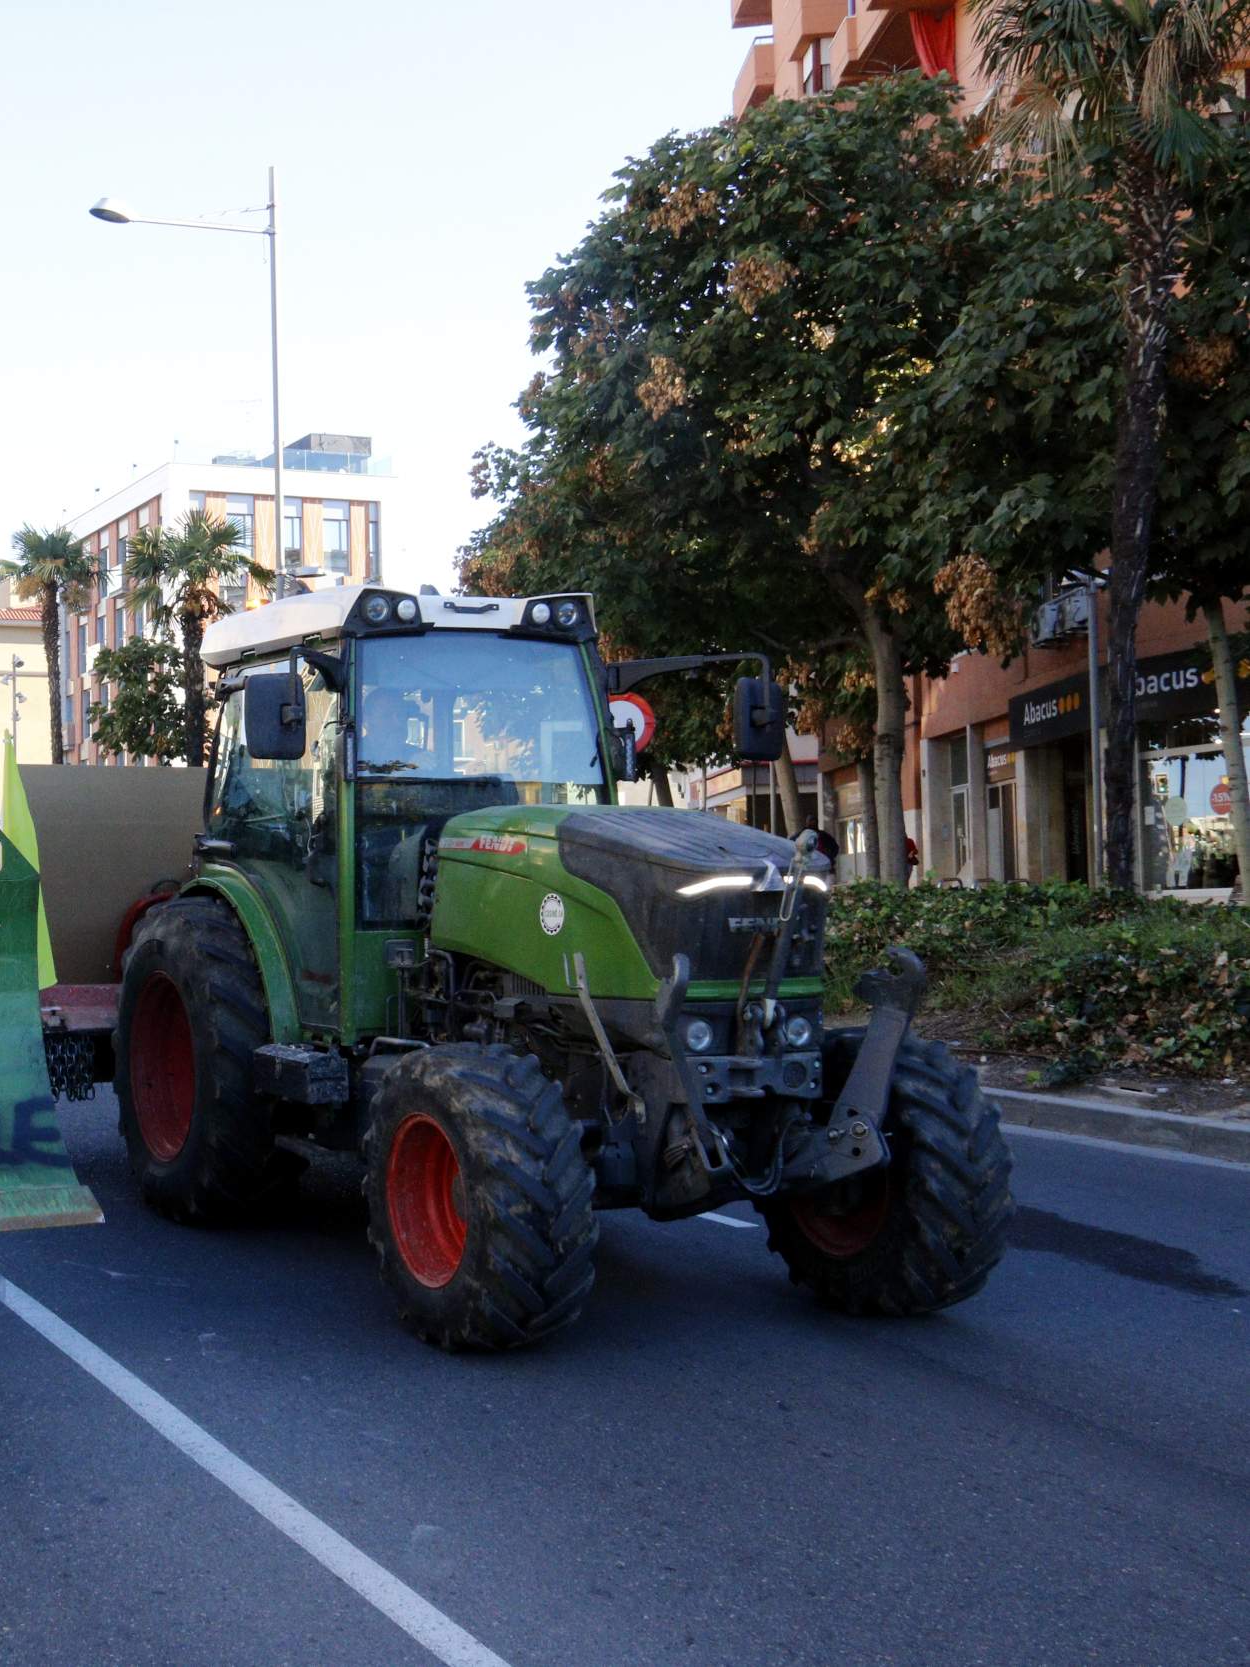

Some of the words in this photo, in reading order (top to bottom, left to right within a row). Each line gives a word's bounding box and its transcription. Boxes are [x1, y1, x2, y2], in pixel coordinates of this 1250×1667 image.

[1135, 668, 1199, 696] bacus
[1023, 699, 1058, 726] Abacus
[987, 752, 1007, 769] Abacus
[478, 835, 517, 854] FENDT
